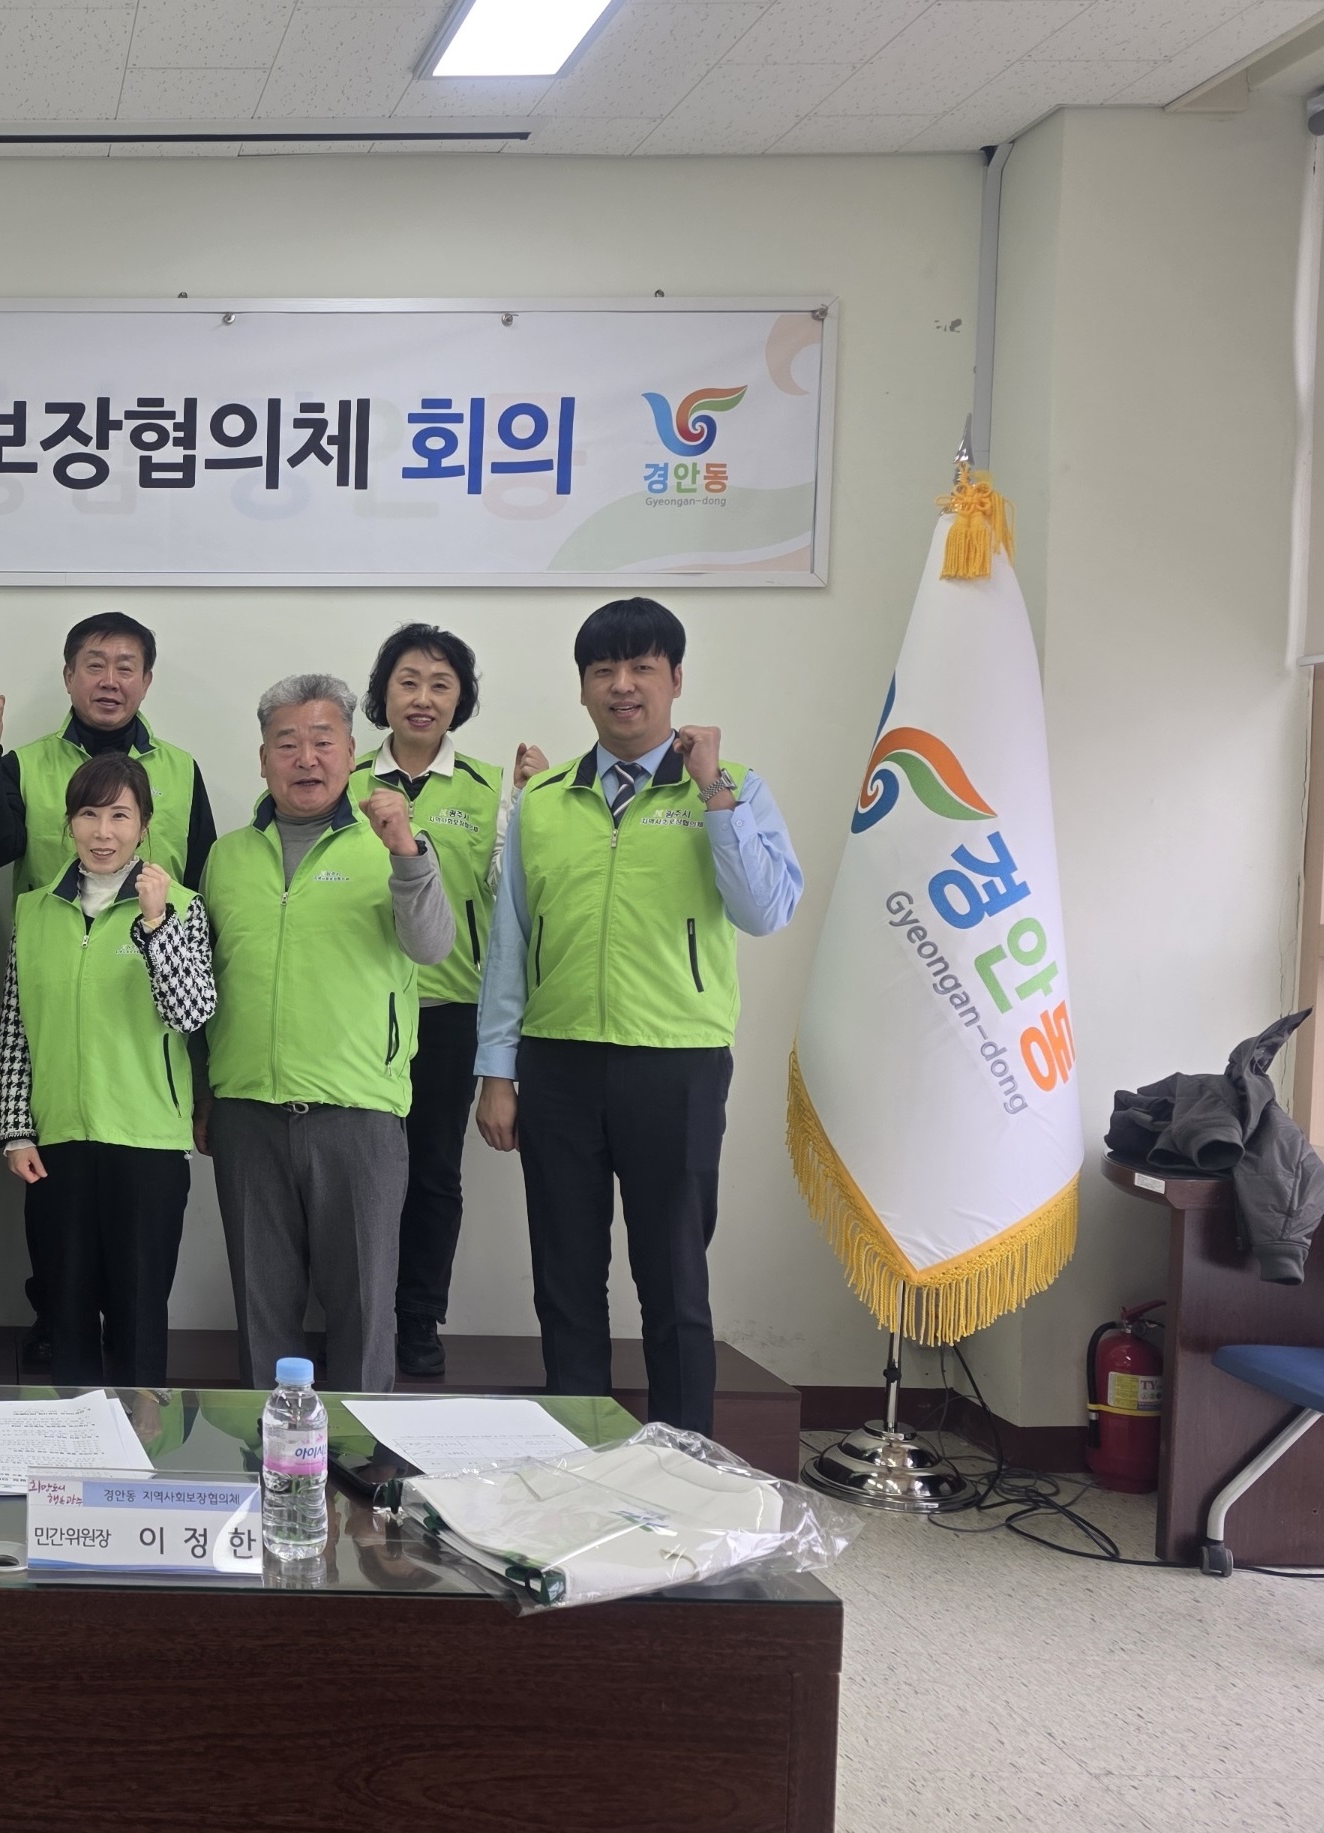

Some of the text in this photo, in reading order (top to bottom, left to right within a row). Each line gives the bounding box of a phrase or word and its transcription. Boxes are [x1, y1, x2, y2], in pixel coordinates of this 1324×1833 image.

[401, 396, 576, 496] 회의
[643, 461, 729, 495] 경안동
[645, 496, 727, 508] Gyeongan-dong
[928, 830, 1076, 1093] 경안동
[885, 890, 1028, 1115] Gyeongan-dong
[103, 1489, 241, 1506] 경안동 지역사회보장협의체
[34, 1526, 112, 1549] 민간위원장
